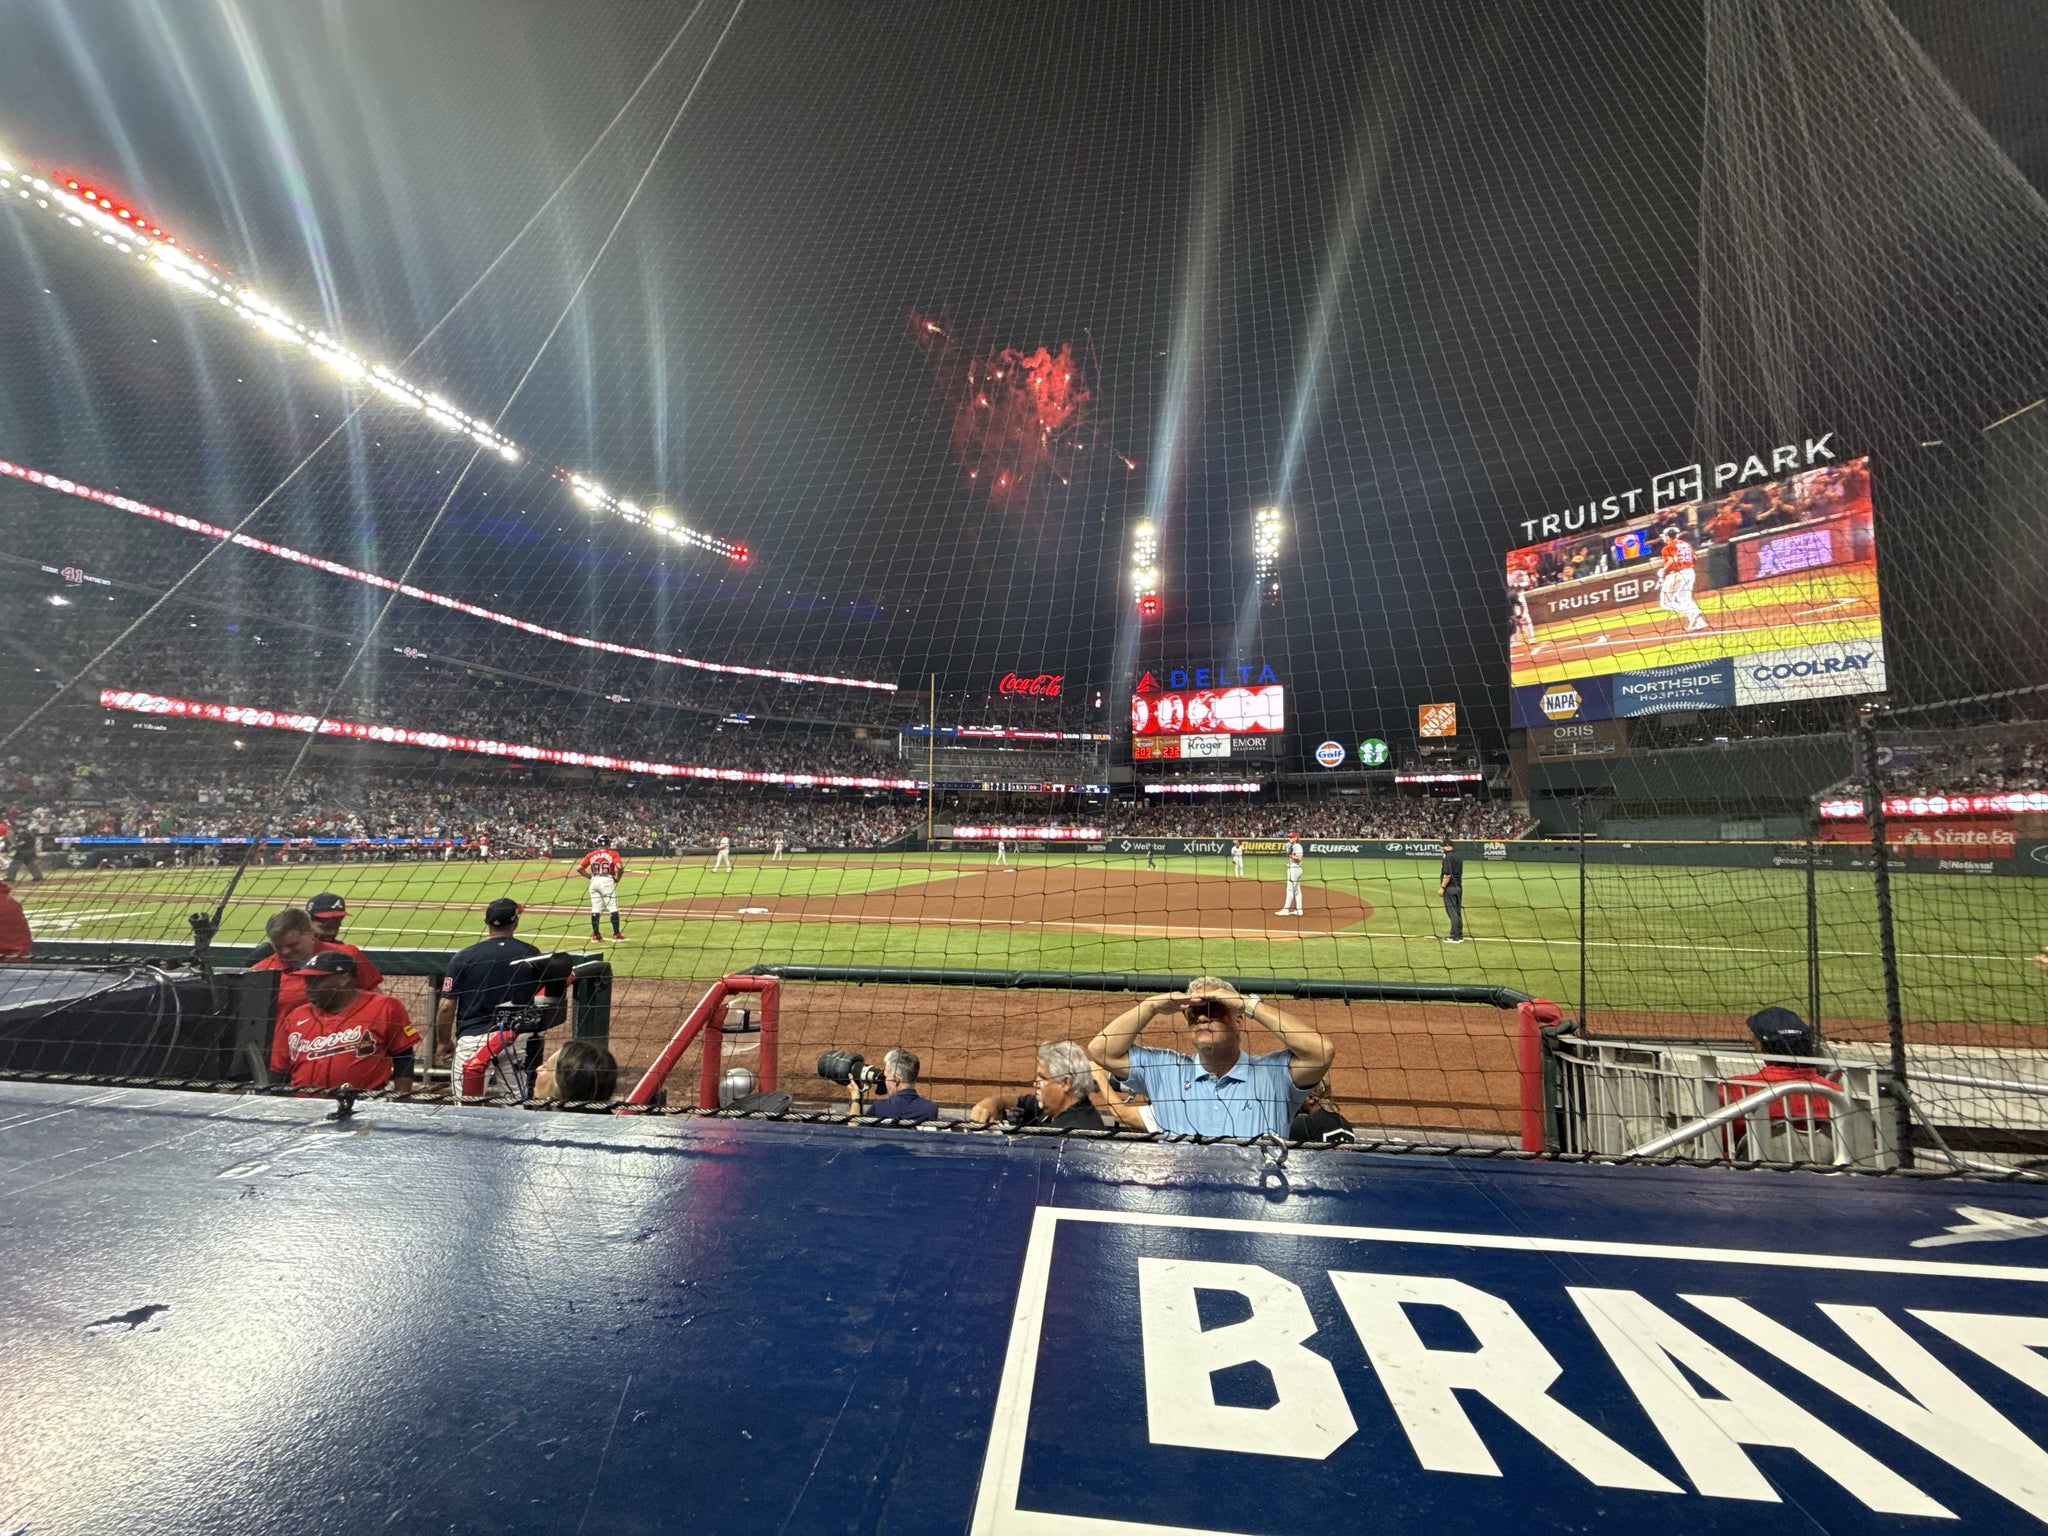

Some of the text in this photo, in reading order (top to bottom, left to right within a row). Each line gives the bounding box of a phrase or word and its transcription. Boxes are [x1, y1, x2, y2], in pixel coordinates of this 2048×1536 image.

[1520, 432, 1836, 541] TRUIST PARK
[61, 566, 83, 584] 41
[1547, 589, 1610, 614] TRUIST
[1752, 651, 1875, 683] COOLRAY
[999, 672, 1064, 697] Coca-Cola
[1171, 664, 1278, 689] DELTA
[1622, 673, 1723, 696] NORTHSIDE
[1546, 693, 1576, 711] NAPA
[1640, 688, 1704, 702] HOSPITAL
[1421, 704, 1455, 736] HOME
[1553, 724, 1594, 738] ORIS
[1188, 737, 1222, 755] Kroger
[1232, 737, 1267, 747] EMORY
[1934, 828, 1988, 845] State
[1183, 840, 1224, 854] xfinity
[1309, 843, 1360, 853] EQUIFAX
[1484, 842, 1506, 850] PAPA
[1952, 861, 1994, 869] National
[288, 1025, 362, 1061] Braves
